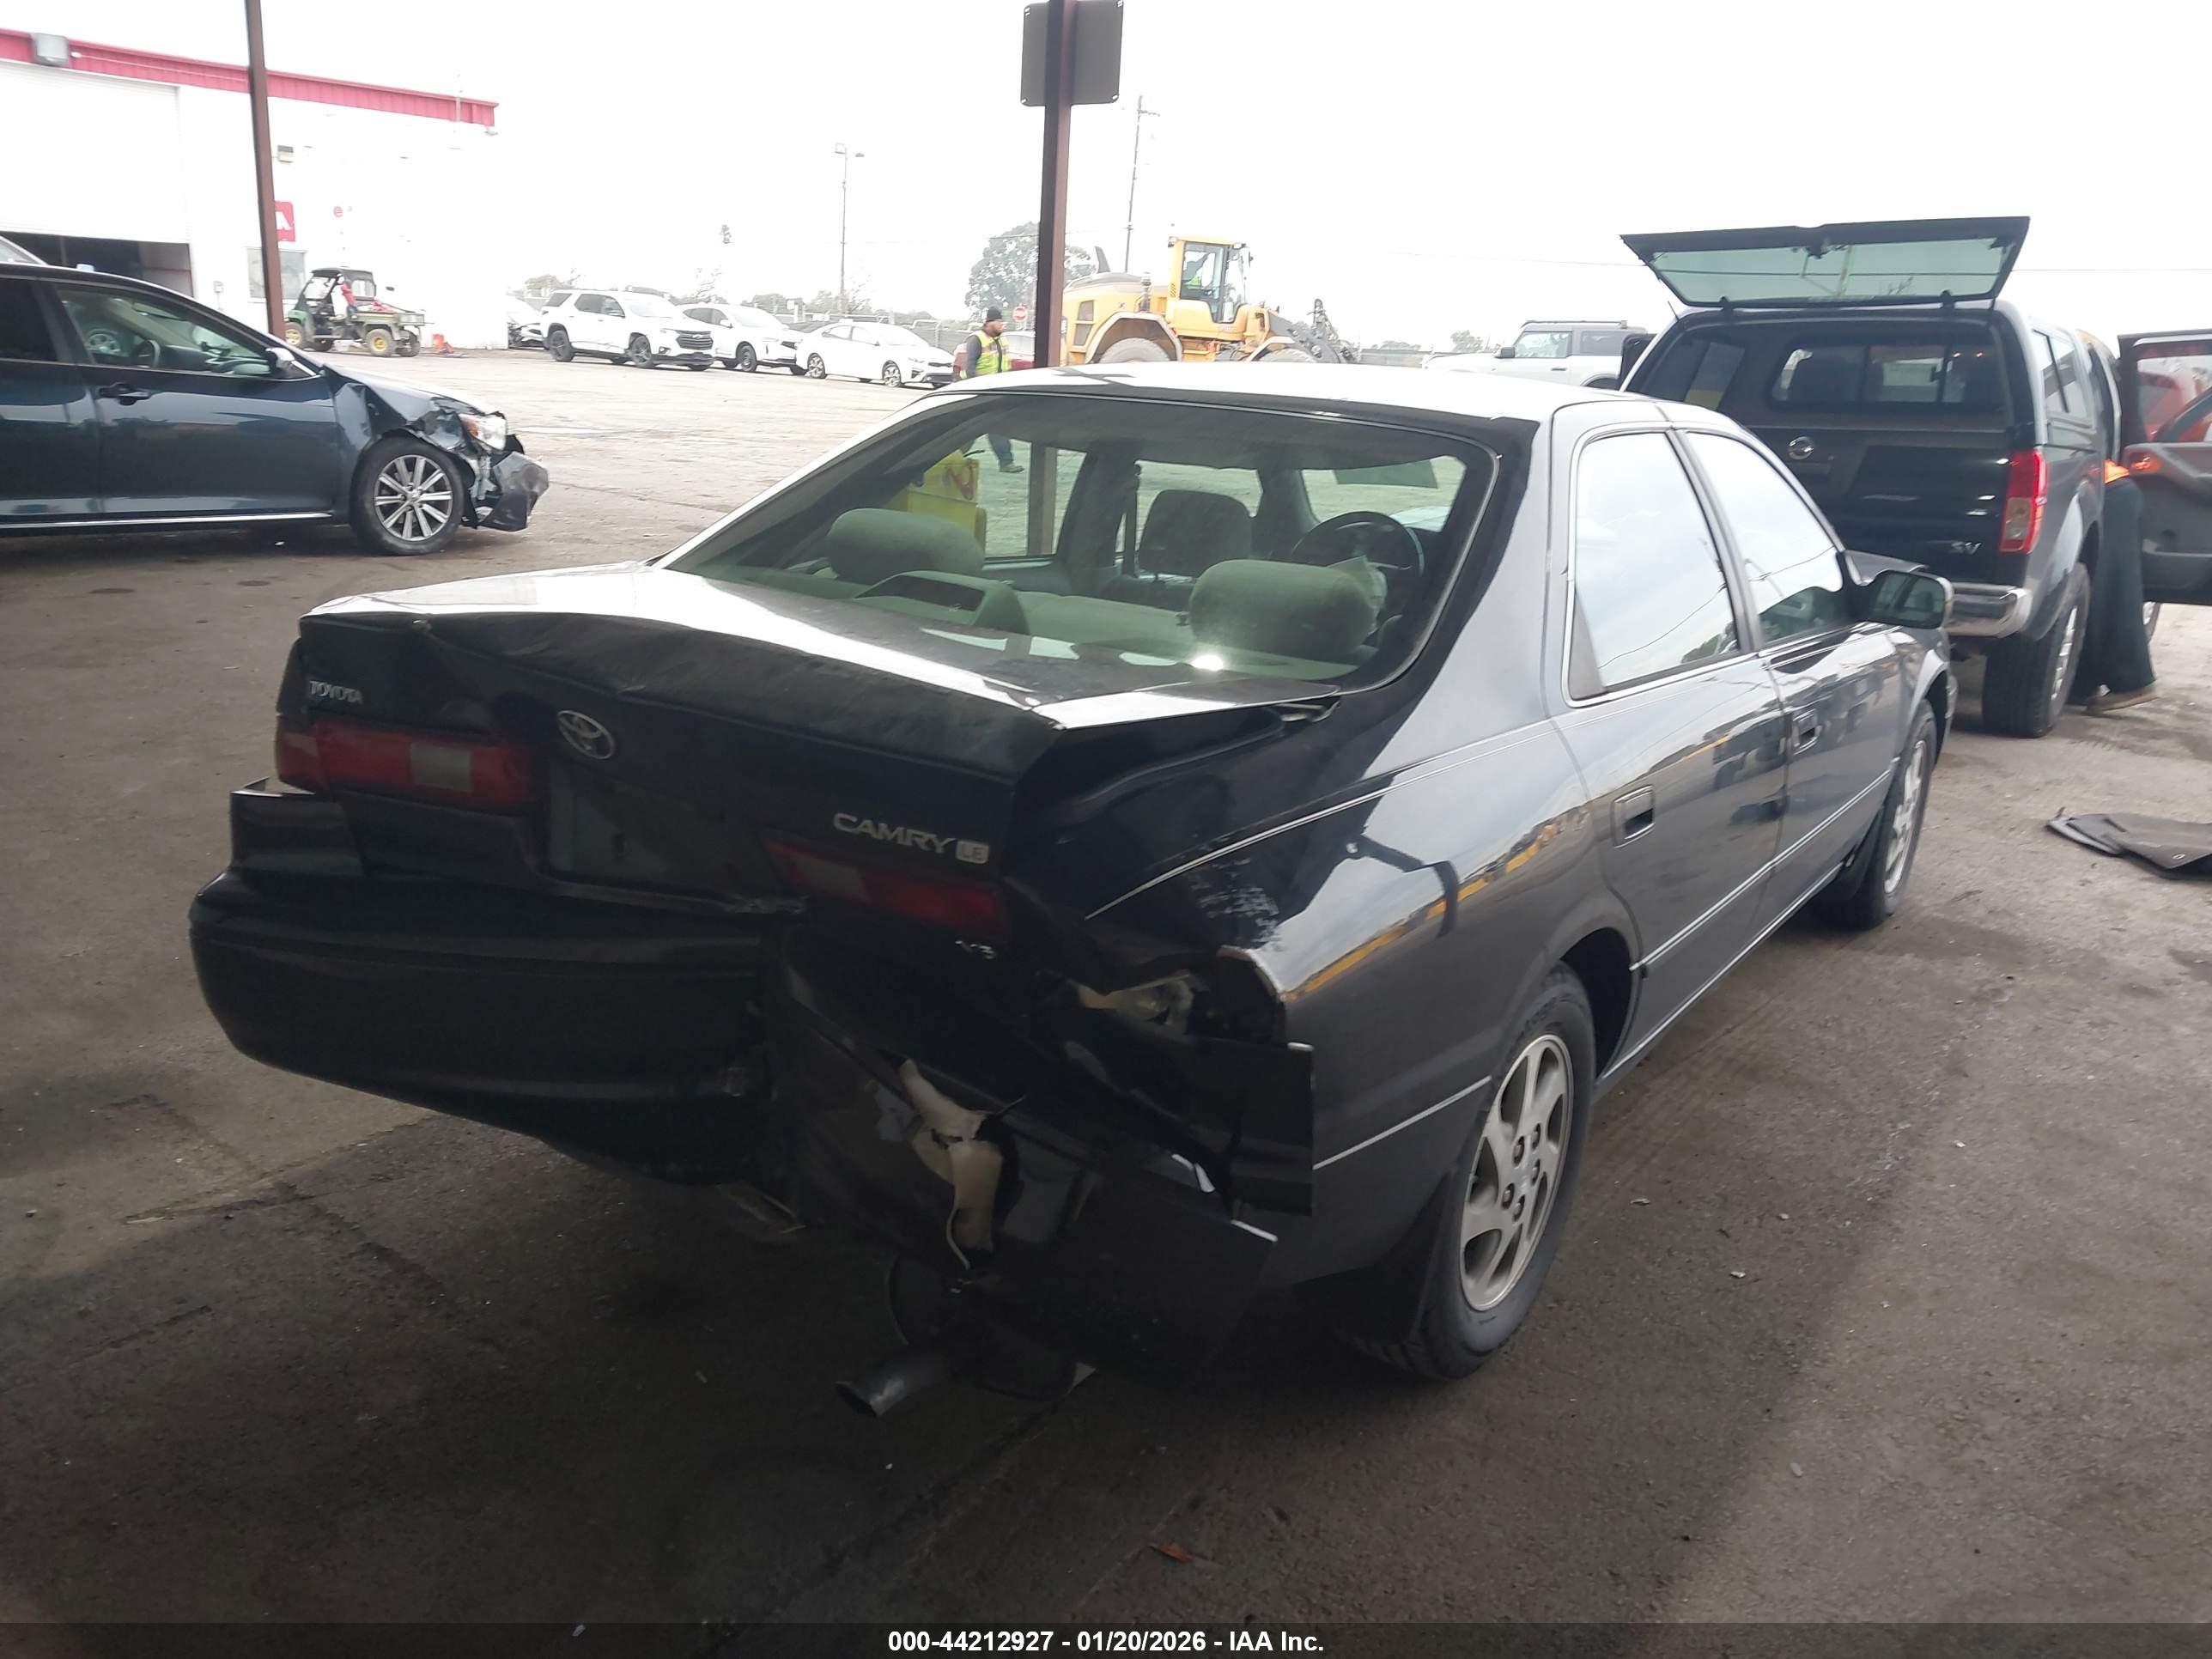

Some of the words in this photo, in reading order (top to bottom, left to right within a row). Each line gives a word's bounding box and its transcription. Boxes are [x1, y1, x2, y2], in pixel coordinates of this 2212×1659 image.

[309, 680, 362, 704] TOYOTA
[833, 812, 956, 854] CAMRY
[957, 842, 987, 861] LE
